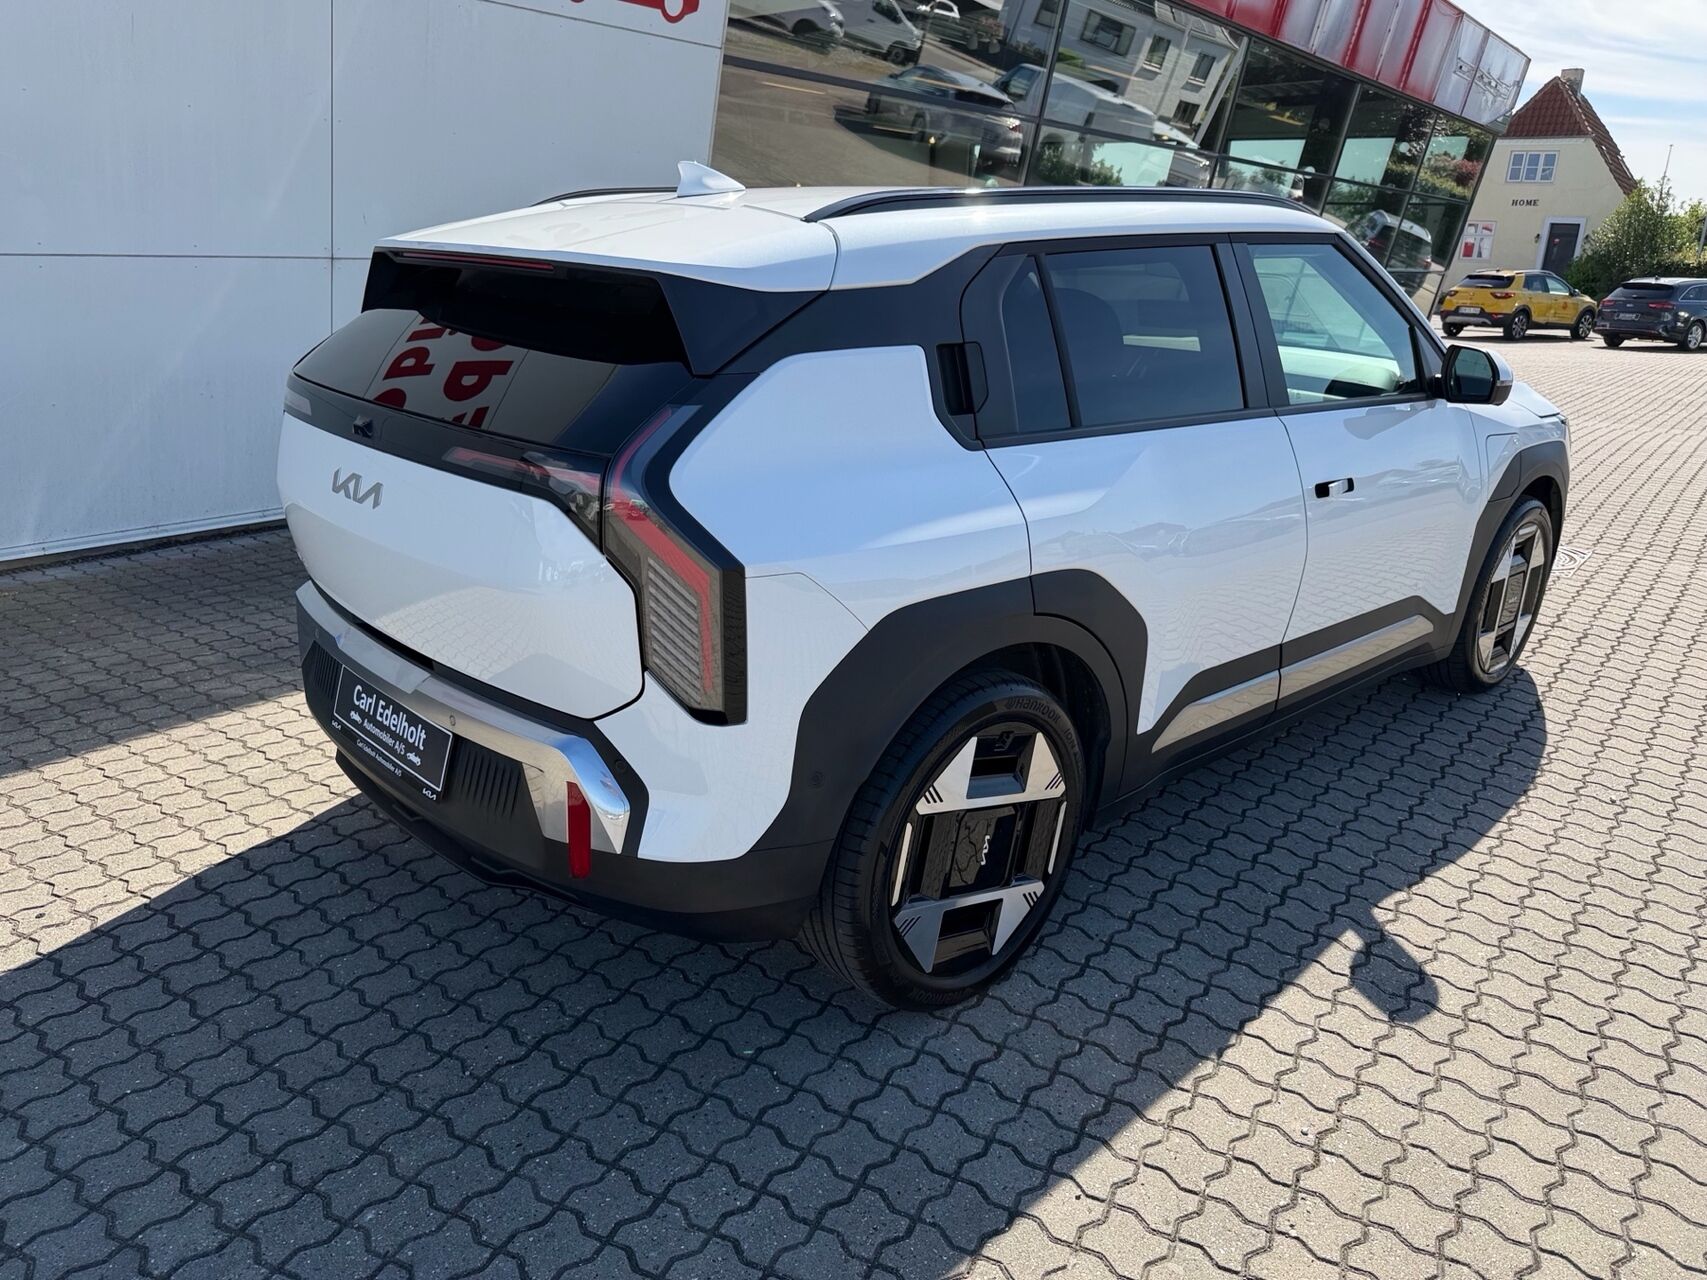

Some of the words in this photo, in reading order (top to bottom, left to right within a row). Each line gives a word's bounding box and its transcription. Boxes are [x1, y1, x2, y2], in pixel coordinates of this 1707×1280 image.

[1511, 199, 1540, 207] HOME
[332, 467, 384, 510] KIA
[353, 684, 376, 715] Carl
[376, 699, 426, 751] Edelholt
[363, 718, 395, 747] Automobiler
[394, 740, 405, 755] A/S
[422, 787, 437, 801] KIA
